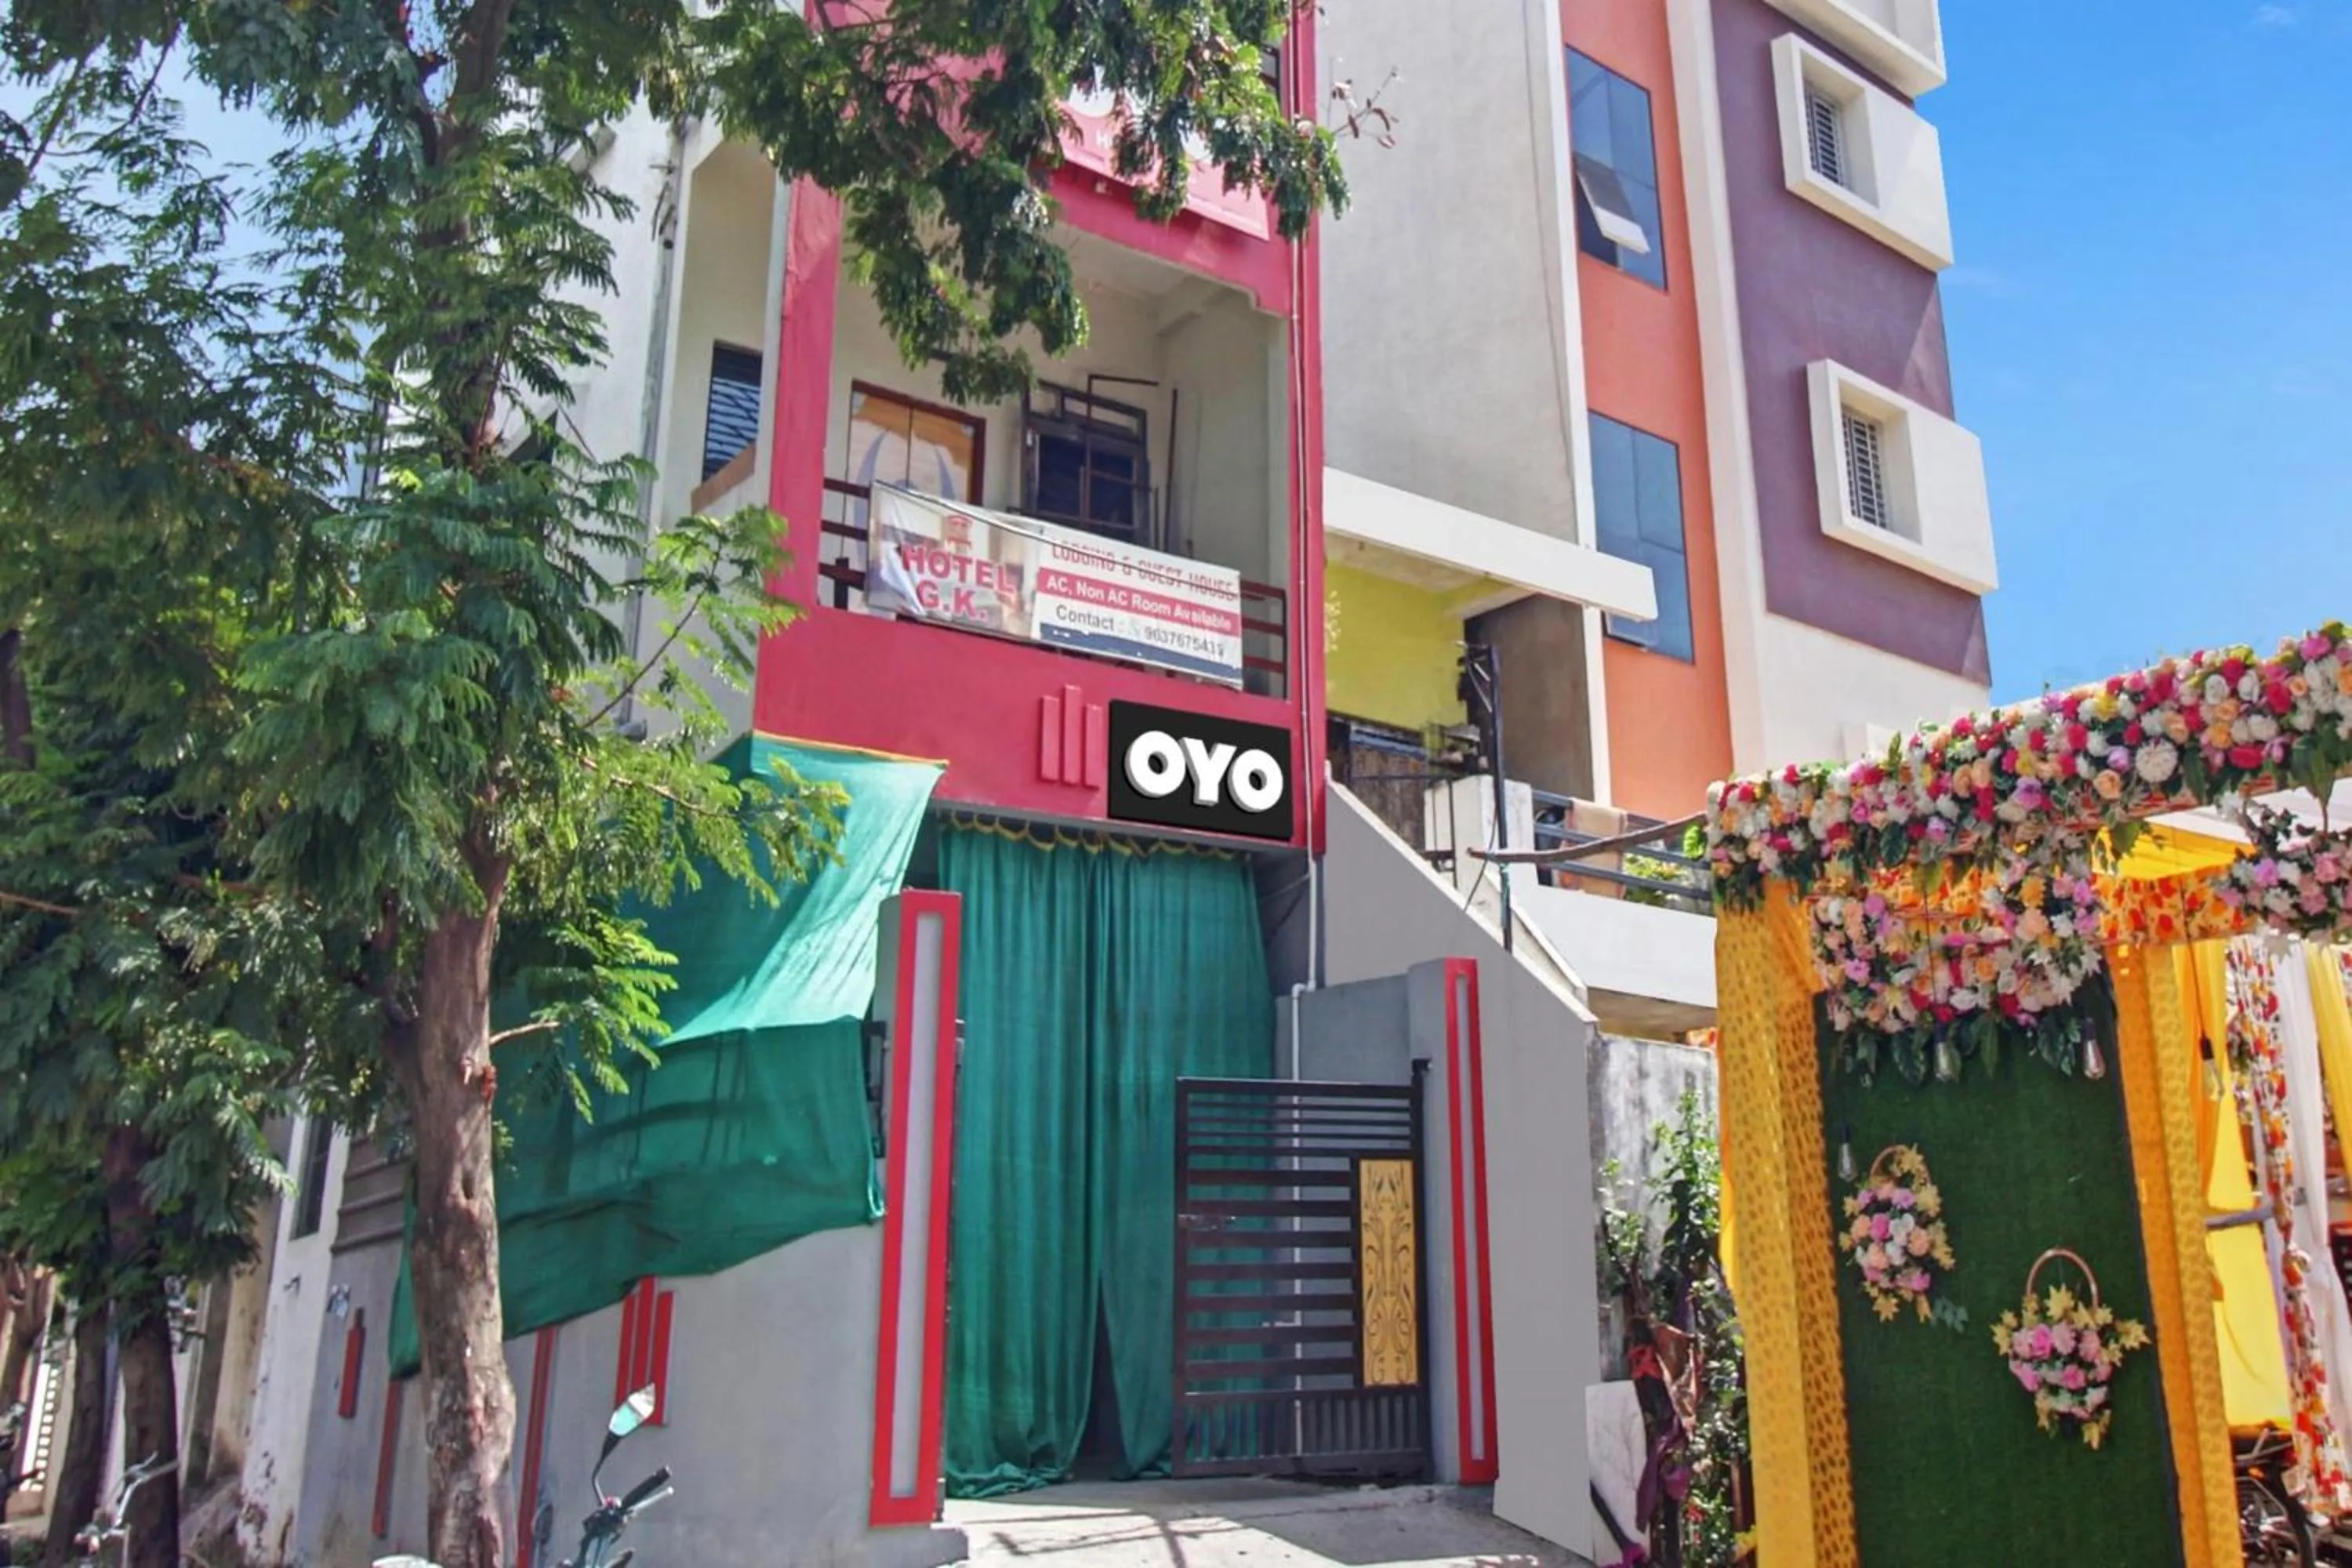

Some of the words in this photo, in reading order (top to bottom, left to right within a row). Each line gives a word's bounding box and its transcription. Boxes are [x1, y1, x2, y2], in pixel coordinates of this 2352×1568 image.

[902, 543, 1015, 593] HOTEL
[1056, 604, 1114, 630] Contact
[1076, 581, 1105, 601] Non
[1108, 589, 1128, 606] AC
[1132, 593, 1171, 616] Room
[1124, 730, 1283, 813] OYO
